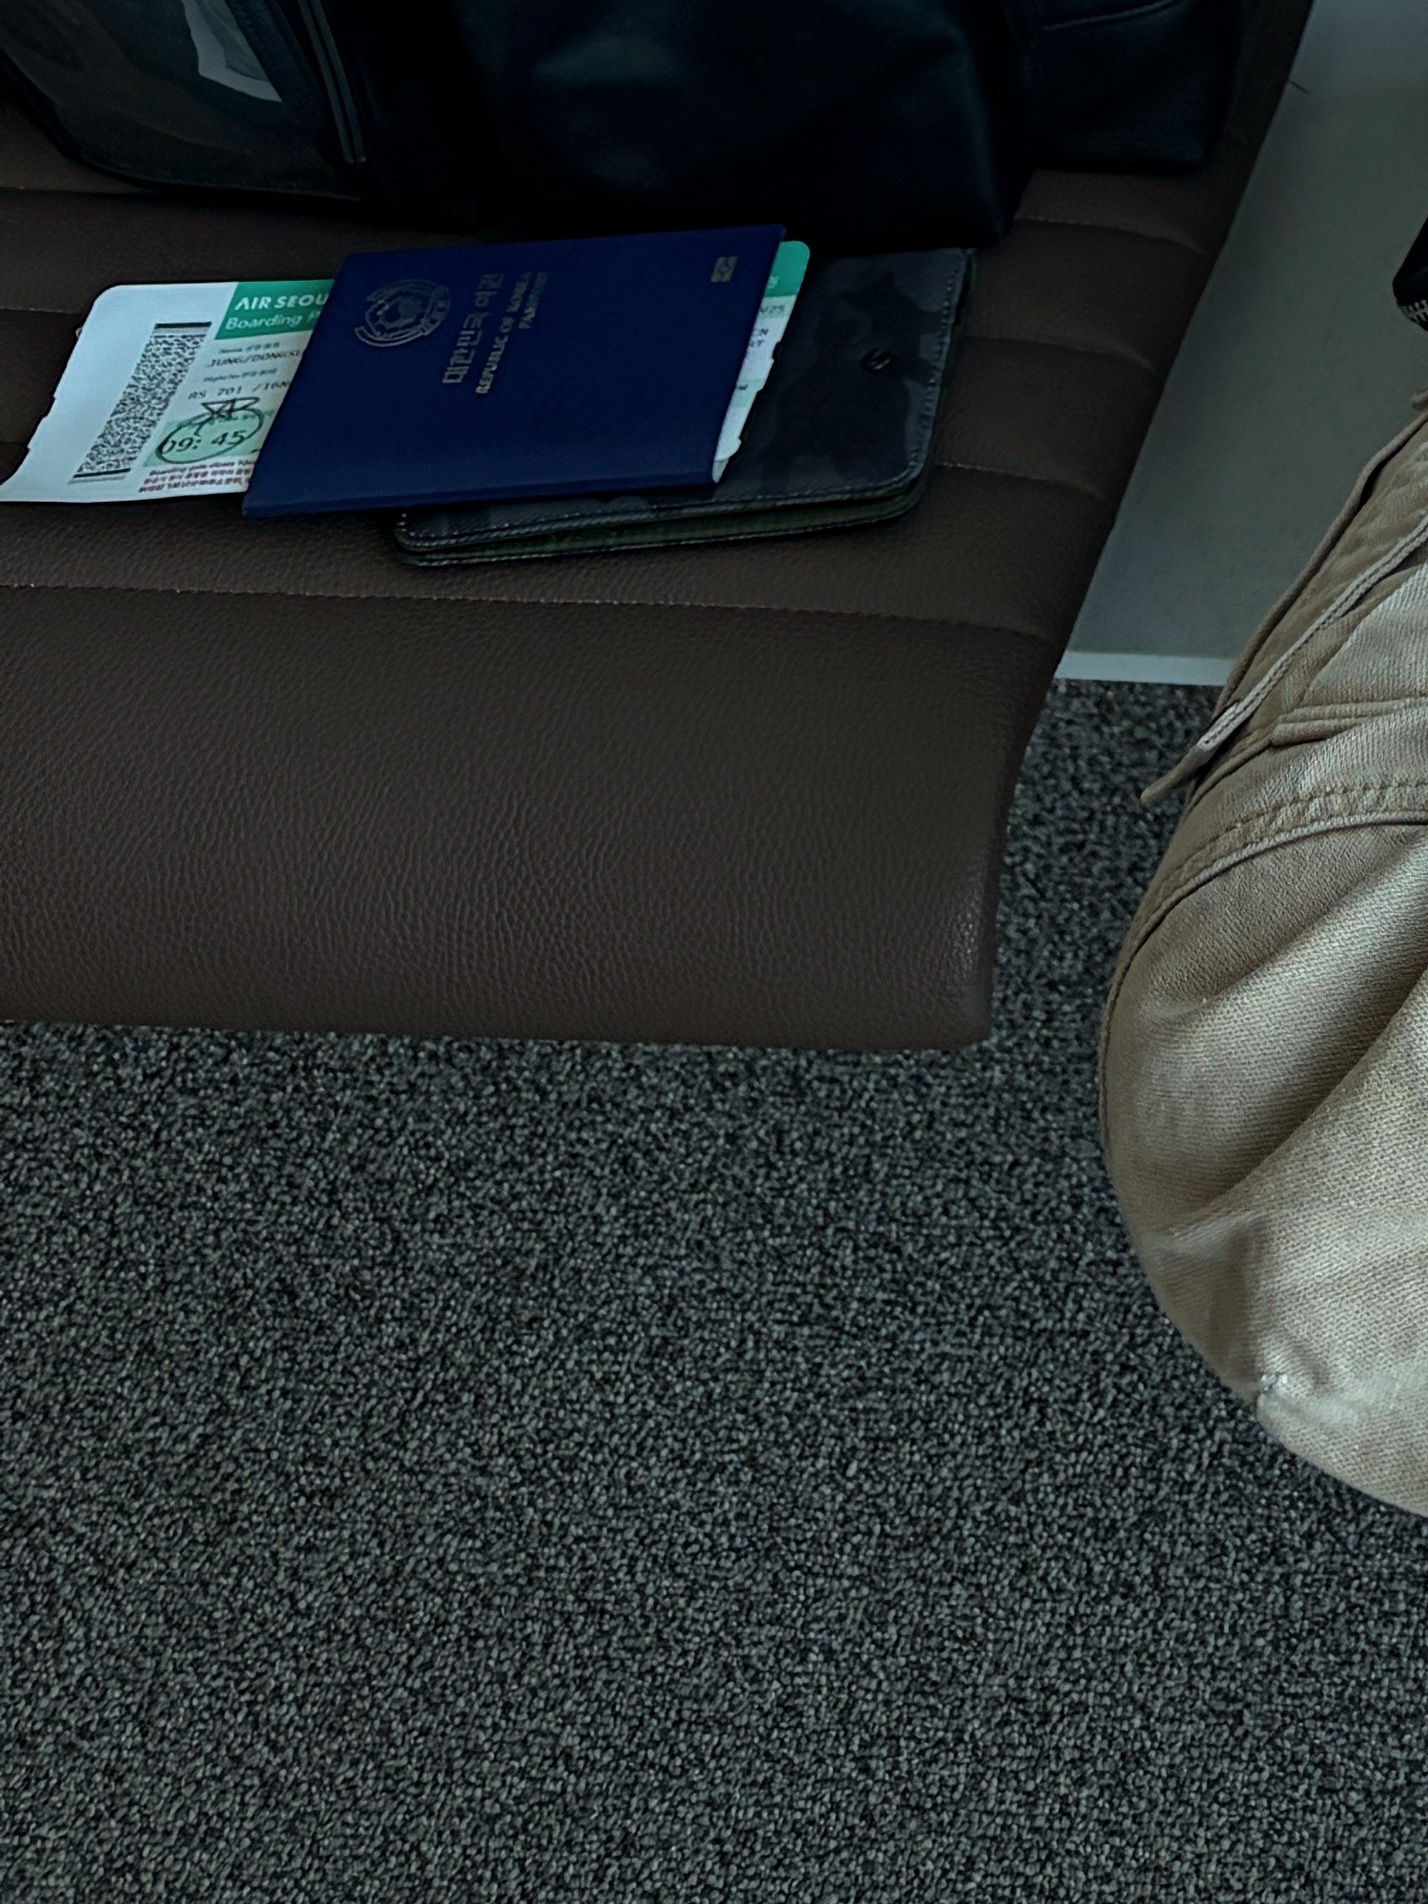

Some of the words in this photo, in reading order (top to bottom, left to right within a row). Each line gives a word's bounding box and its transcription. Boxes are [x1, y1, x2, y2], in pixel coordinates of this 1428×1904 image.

[234, 296, 273, 311] AIR
[274, 293, 330, 309] SEOU
[225, 314, 303, 330] Boarding
[442, 312, 489, 384] 대한민국
